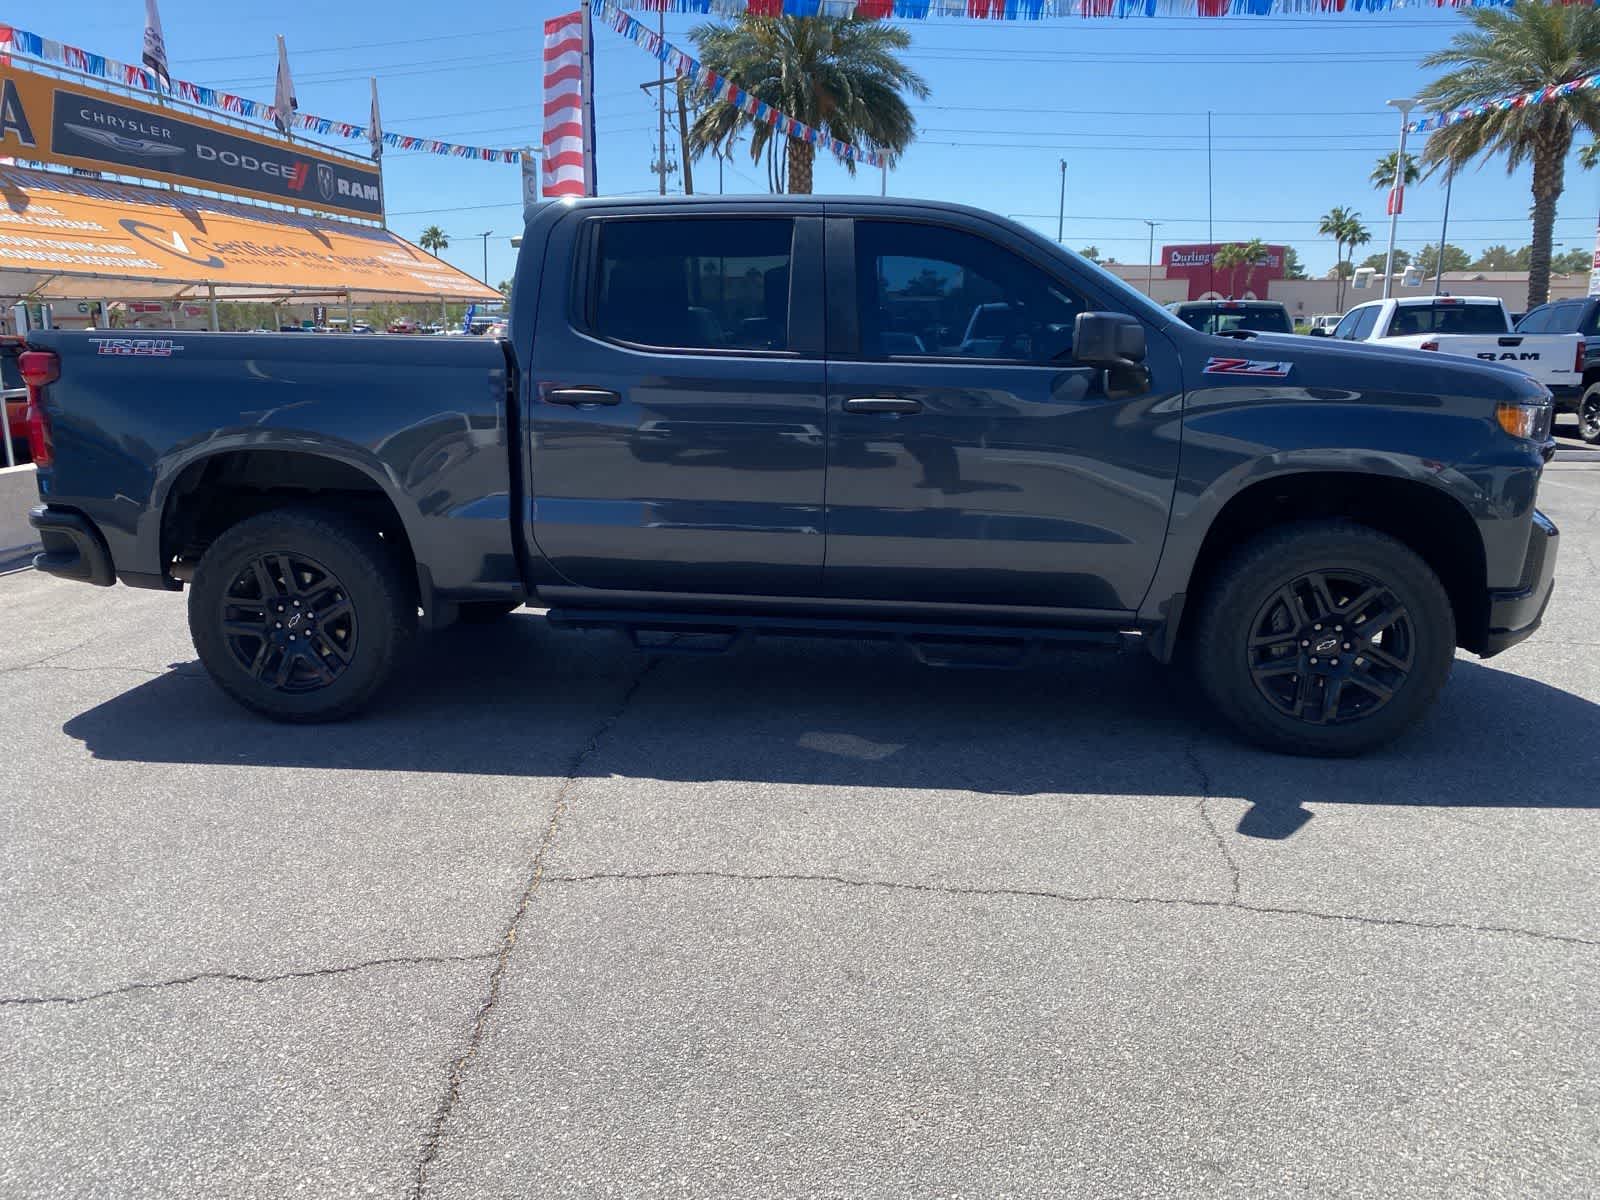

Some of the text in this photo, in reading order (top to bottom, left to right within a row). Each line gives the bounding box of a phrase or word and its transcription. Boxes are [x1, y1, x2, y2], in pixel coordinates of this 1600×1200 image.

[80, 109, 172, 138] CHRYSLER
[196, 143, 297, 179] DODGE
[337, 178, 379, 201] RAM
[88, 338, 185, 350] TRAIL
[1202, 356, 1294, 377] Z71
[1477, 352, 1541, 361] RAM
